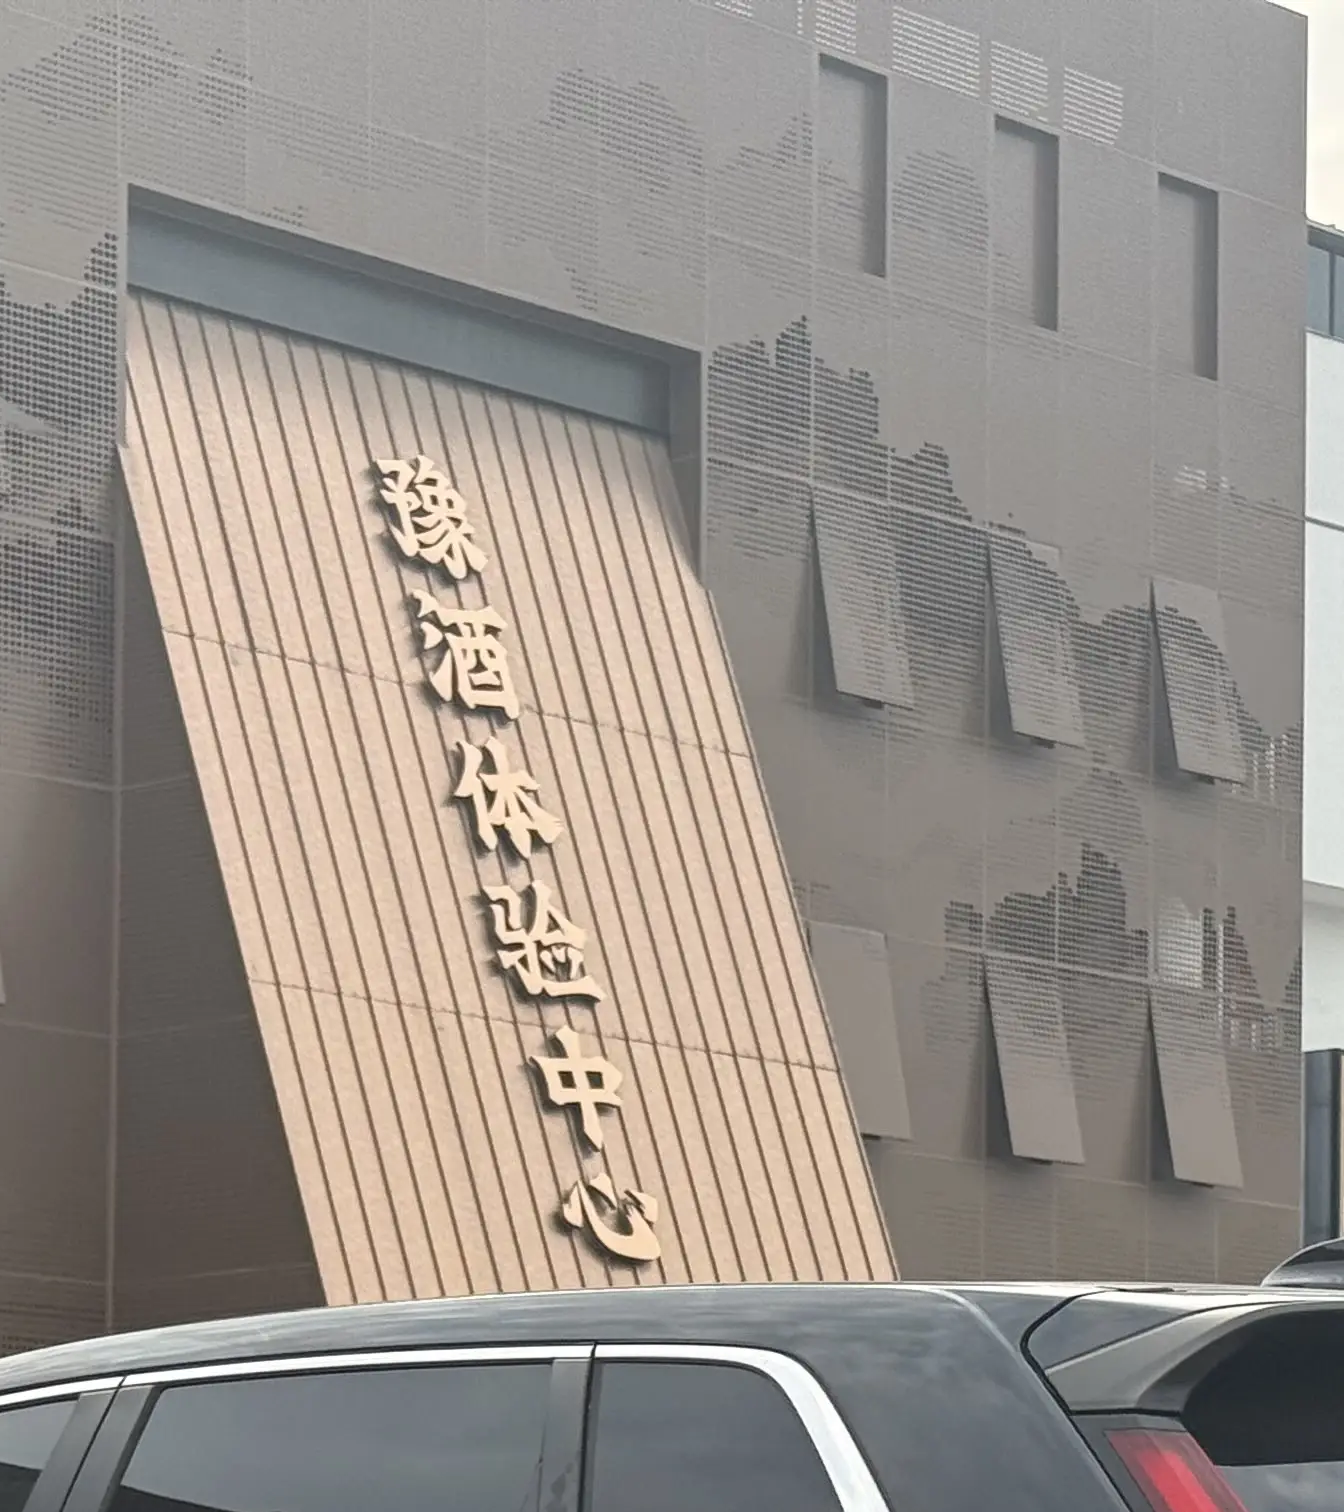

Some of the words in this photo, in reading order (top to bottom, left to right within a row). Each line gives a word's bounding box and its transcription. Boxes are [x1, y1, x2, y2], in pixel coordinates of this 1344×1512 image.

[374, 454, 661, 1262] 豫酒体验中心
